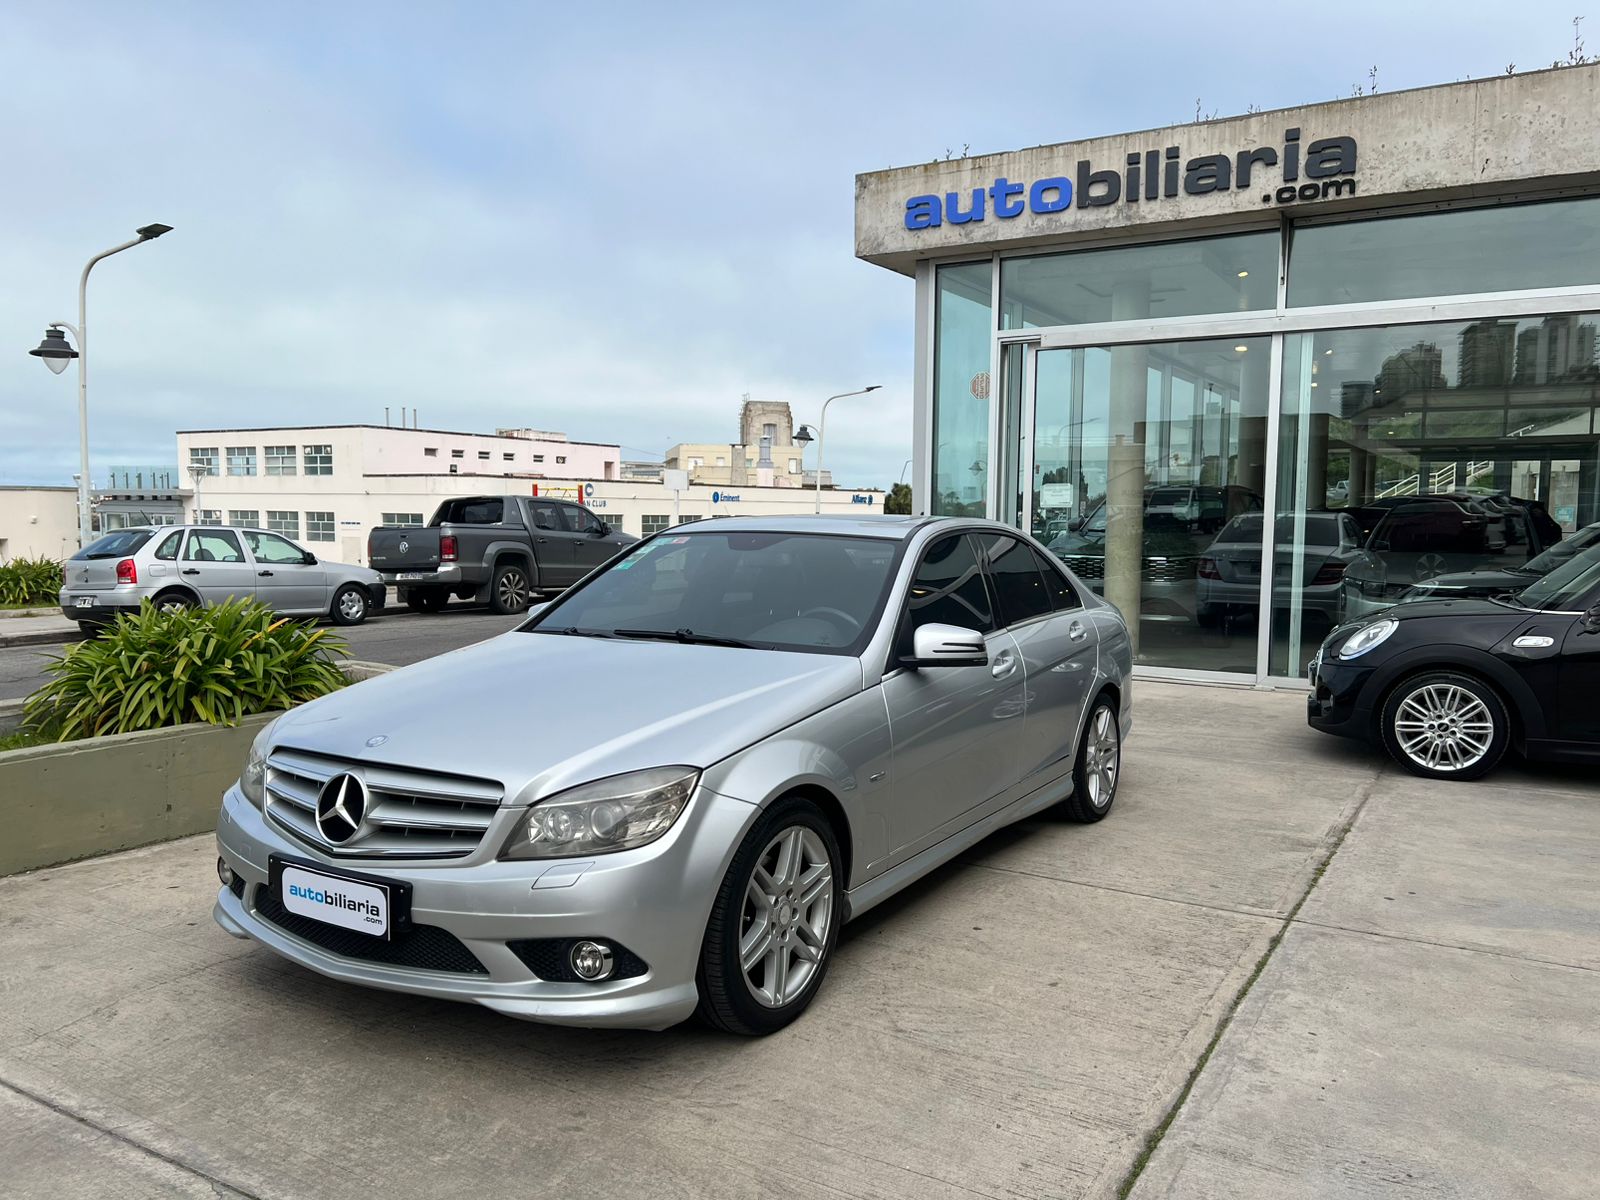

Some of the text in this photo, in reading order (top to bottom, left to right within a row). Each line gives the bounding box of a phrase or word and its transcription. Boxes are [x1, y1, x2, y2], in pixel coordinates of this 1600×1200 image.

[904, 127, 1358, 231] autobiliaria
[1262, 178, 1356, 203] .com
[592, 500, 607, 508] CLUB
[289, 884, 380, 917] autobiliaria
[363, 916, 383, 926] .com
